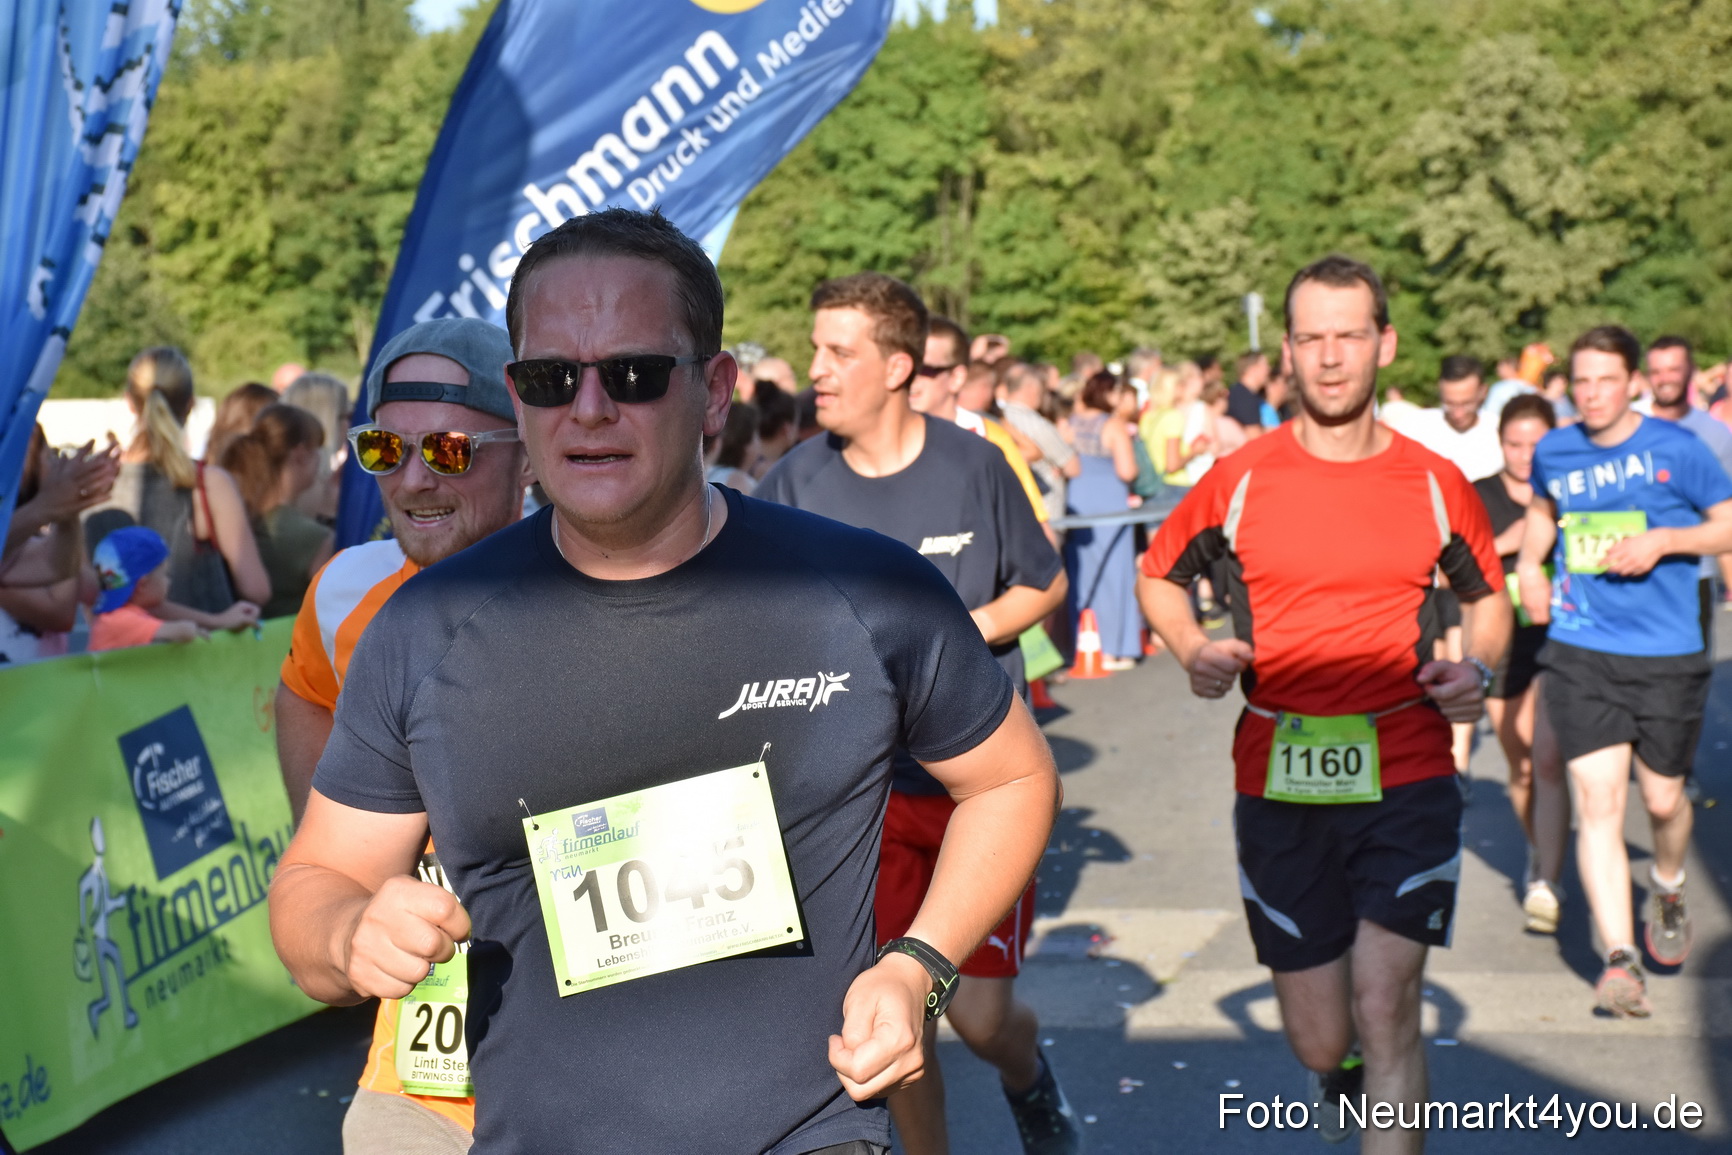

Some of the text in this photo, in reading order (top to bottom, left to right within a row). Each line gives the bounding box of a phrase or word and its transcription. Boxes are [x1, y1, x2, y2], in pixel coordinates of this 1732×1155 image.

[626, 0, 854, 211] Druck und Medie
[718, 677, 817, 720] JURA
[741, 698, 807, 711] SPORT SERVICE
[146, 754, 202, 800] Fischer
[1281, 745, 1363, 778] 1160
[562, 820, 641, 855] firmenlauf
[564, 846, 600, 860] neumarkt
[572, 834, 756, 934] 1045
[731, 922, 755, 937] e.V.
[145, 934, 233, 1009] neumarkt
[409, 1002, 464, 1056] 20
[411, 1070, 472, 1083] BITWINGS Gm
[414, 1056, 470, 1072] Lintl Stef
